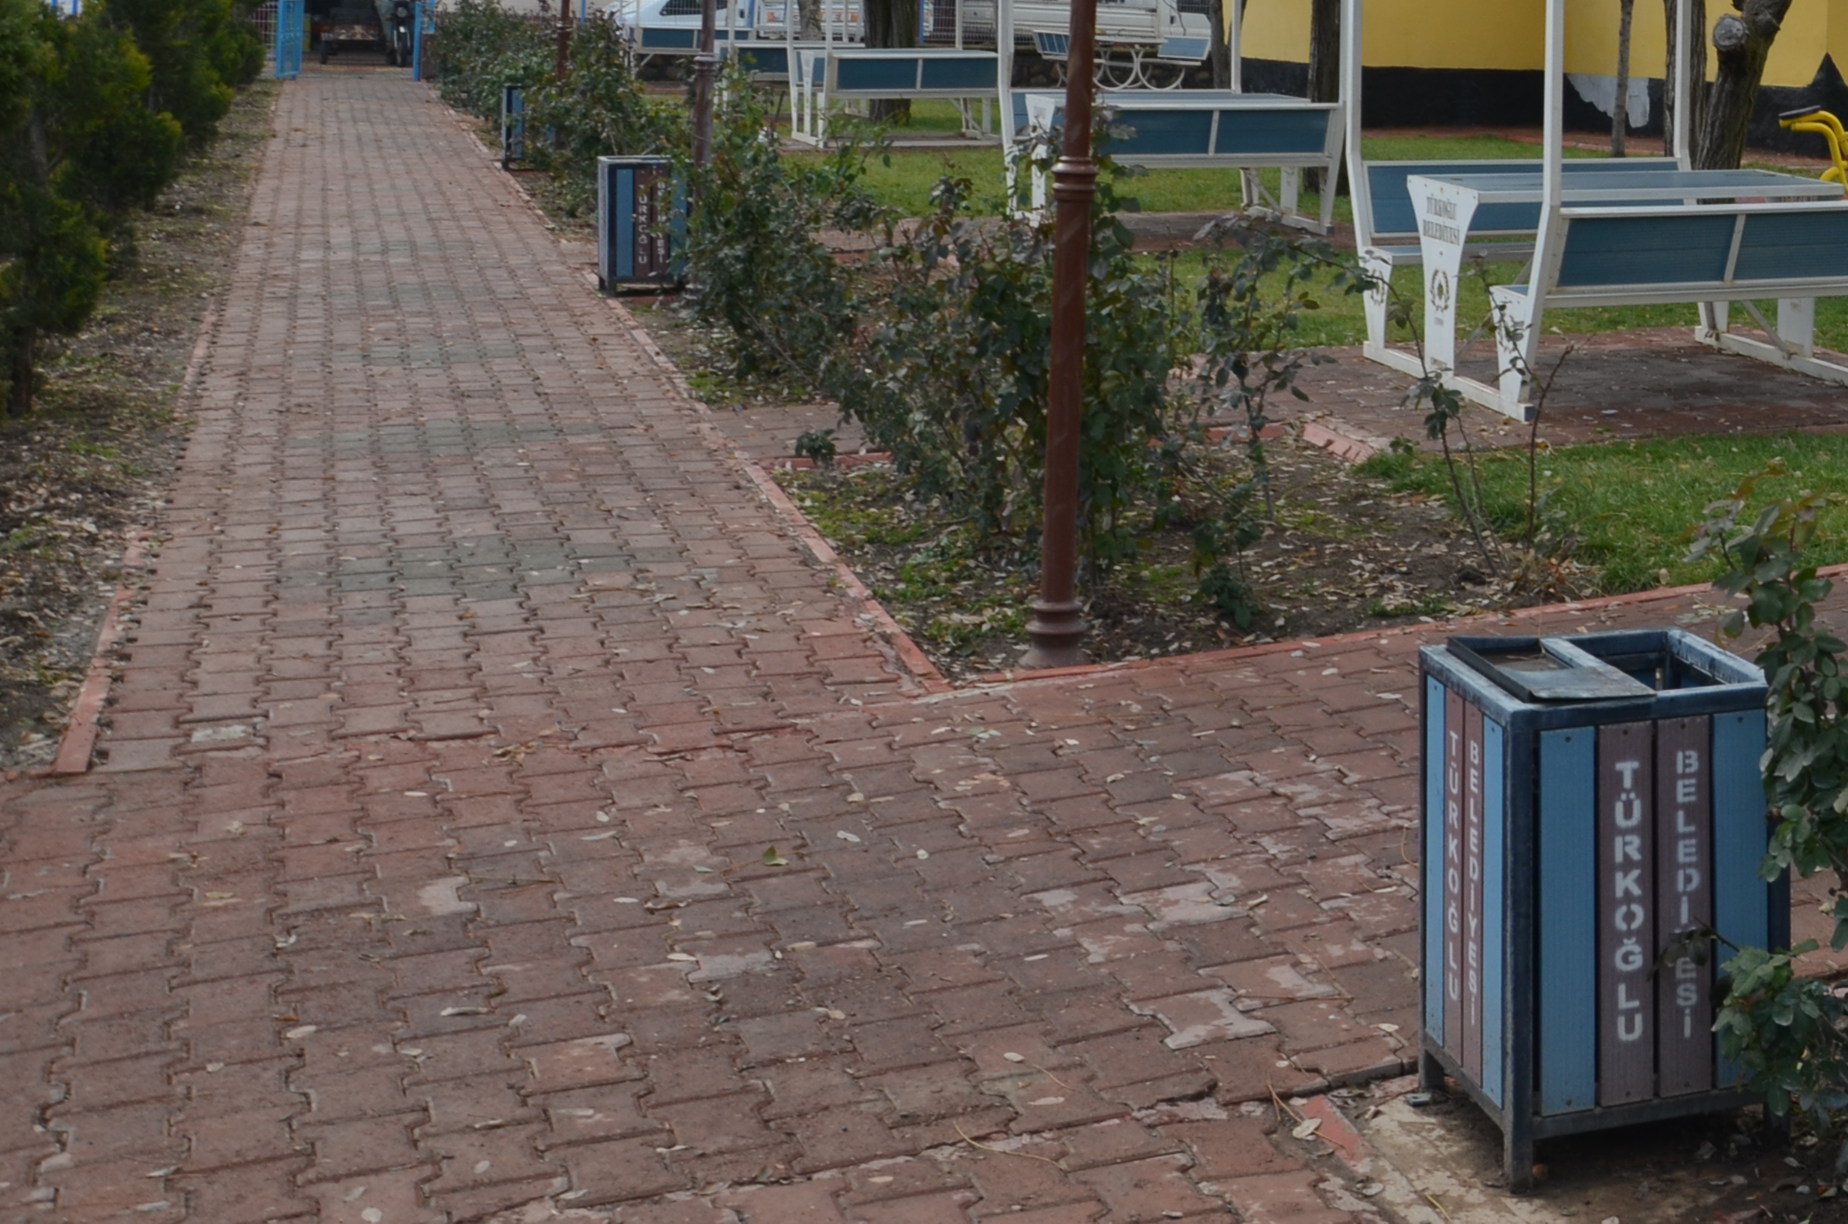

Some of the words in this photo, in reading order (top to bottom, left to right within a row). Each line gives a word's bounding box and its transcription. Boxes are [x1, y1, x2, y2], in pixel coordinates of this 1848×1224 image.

[1448, 730, 1459, 1001] TÜRKOĞLU
[1468, 740, 1479, 1026] BELEDİYESİ
[1614, 760, 1645, 1043] TÜRKOĞLU
[1675, 749, 1700, 1039] BELEDİESİ
